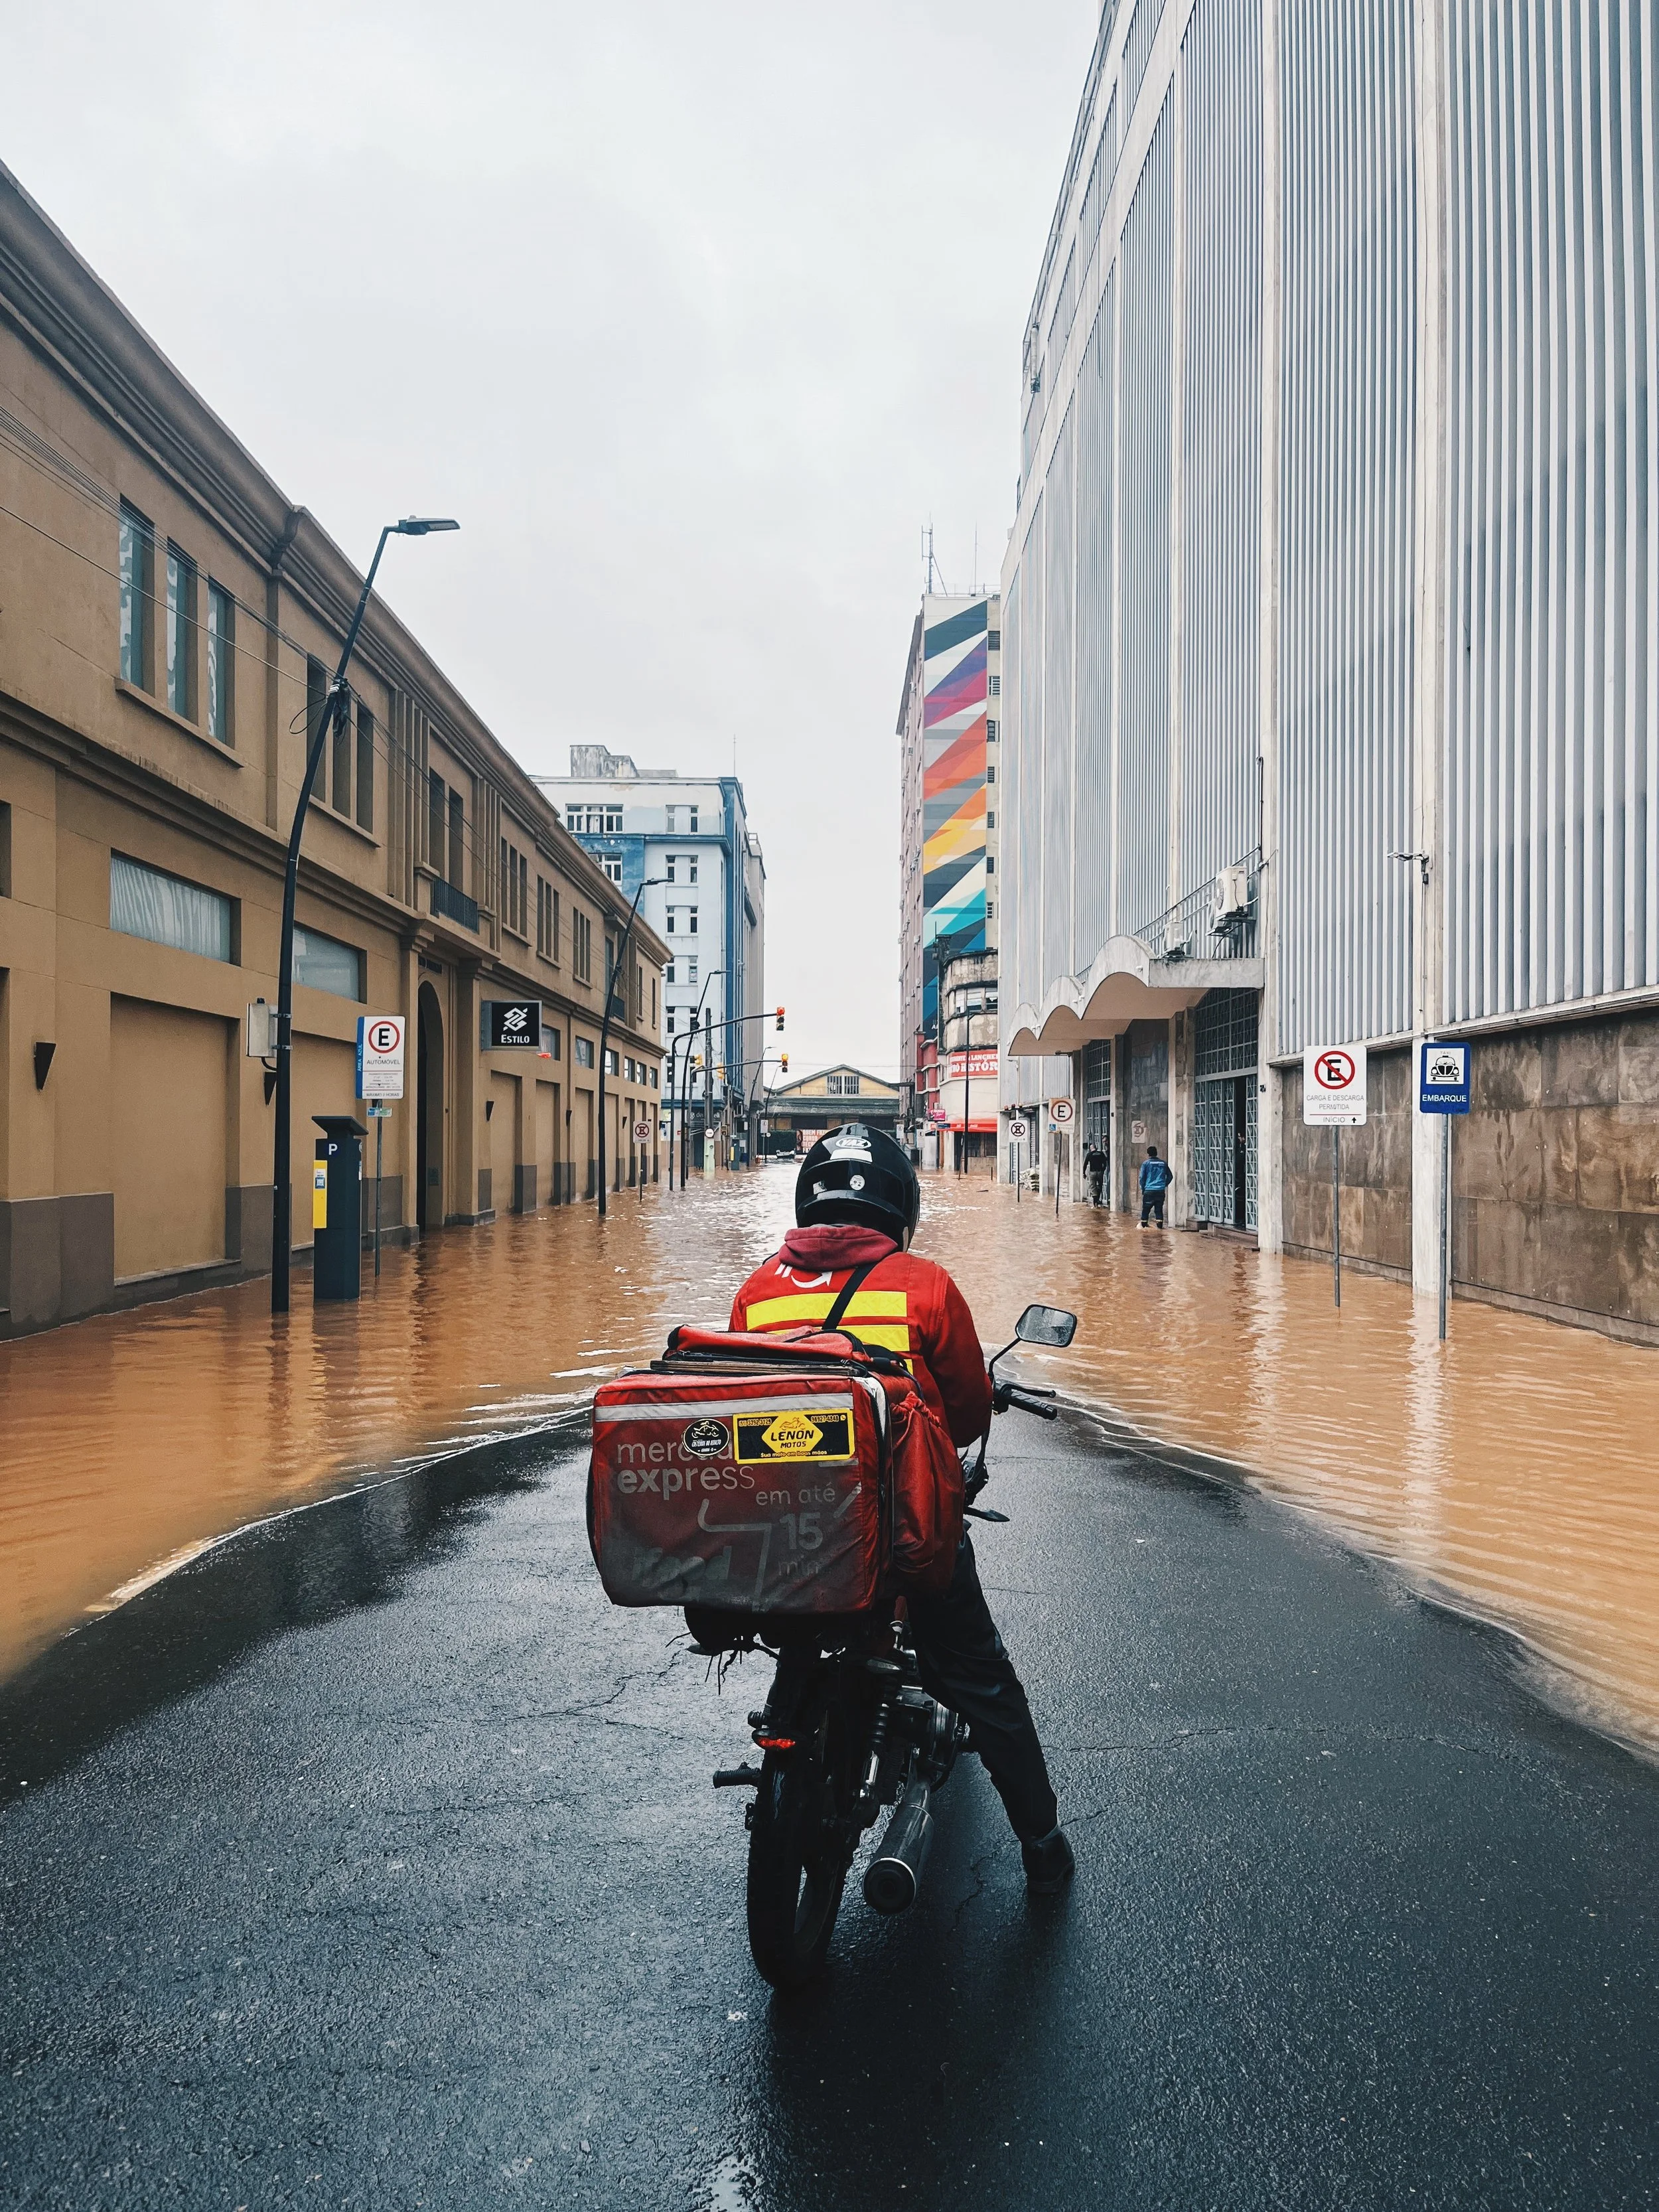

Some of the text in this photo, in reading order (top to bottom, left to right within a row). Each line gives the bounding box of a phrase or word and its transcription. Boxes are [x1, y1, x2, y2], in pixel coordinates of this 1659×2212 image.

[378, 1028, 390, 1047] E
[501, 1034, 530, 1043] ESTILO
[1327, 1059, 1342, 1081] E
[1058, 1105, 1066, 1118] E
[328, 1143, 338, 1155] P
[770, 1430, 814, 1441] LENON
[618, 1466, 755, 1501] express
[755, 1482, 836, 1506] em até
[780, 1512, 824, 1551] 15
